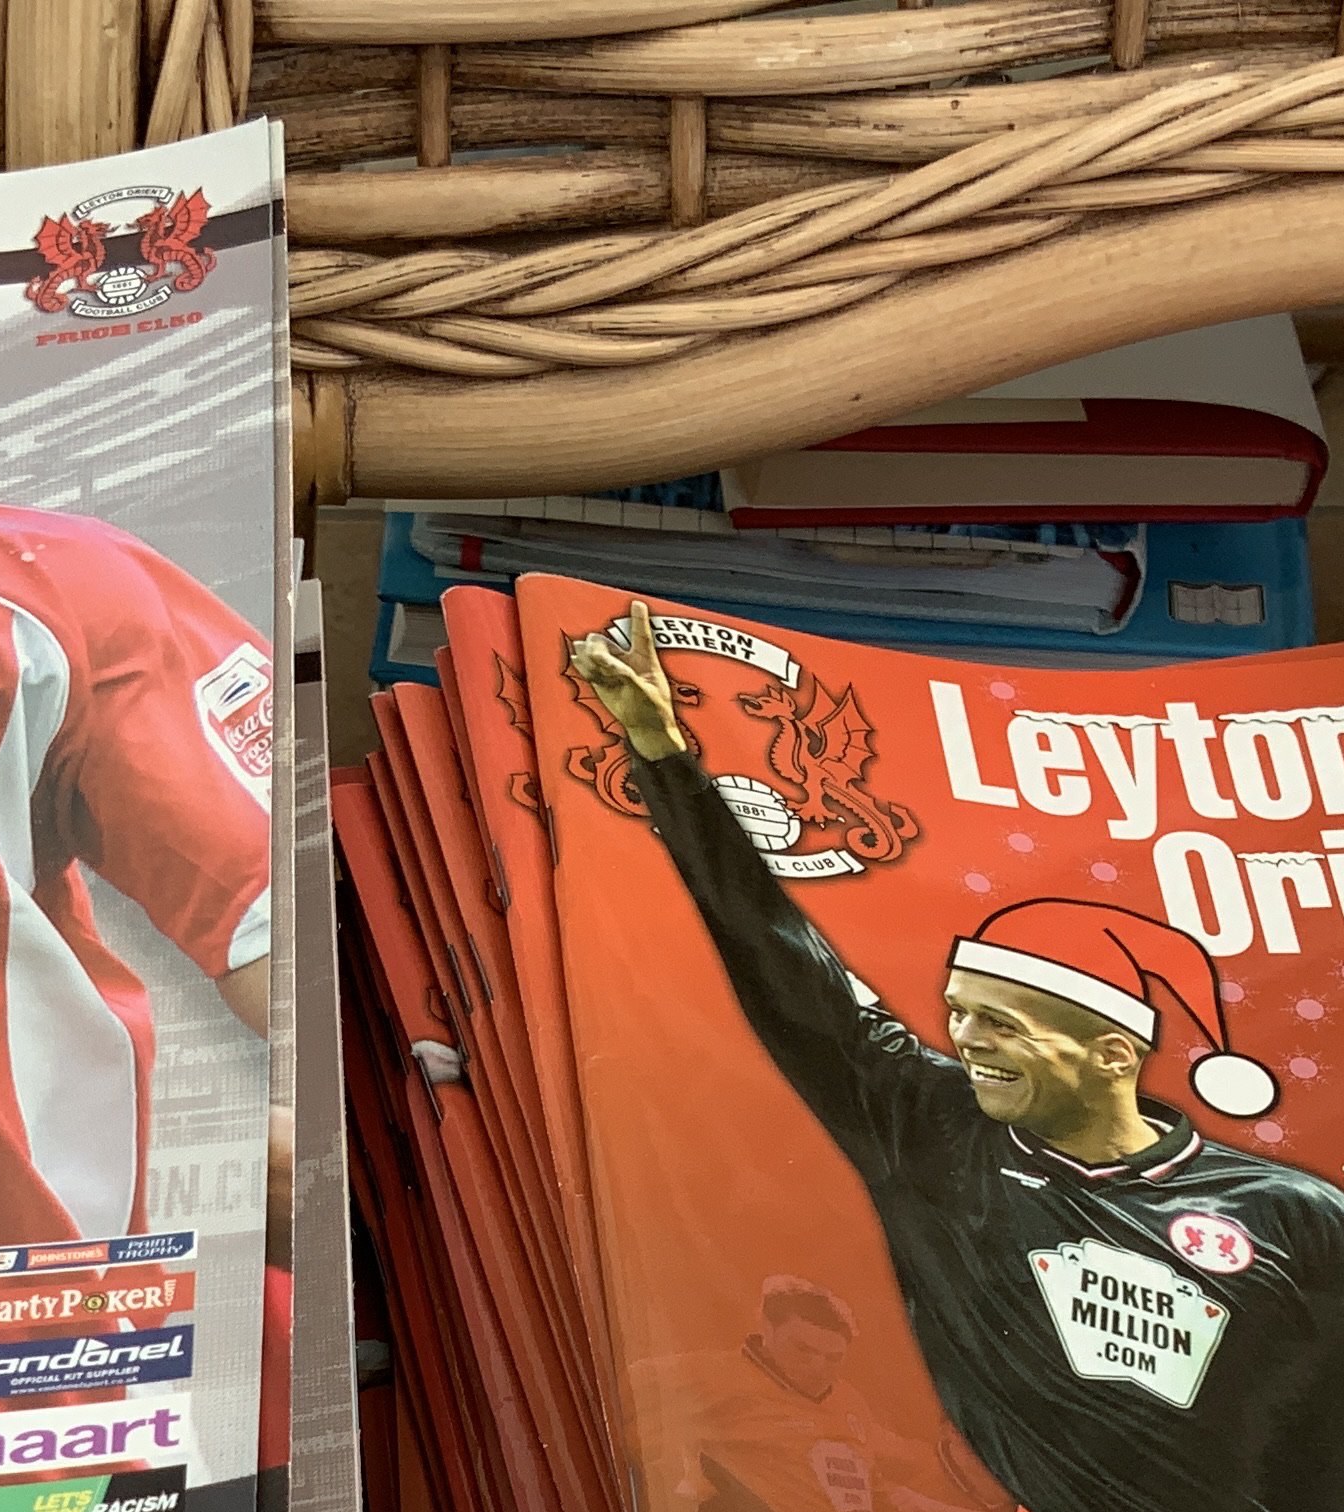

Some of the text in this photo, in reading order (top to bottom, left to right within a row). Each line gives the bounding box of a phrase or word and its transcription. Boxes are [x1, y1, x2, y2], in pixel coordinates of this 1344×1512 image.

[651, 617, 754, 650] LEYTON
[655, 631, 756, 661] ORIENT
[736, 803, 767, 817] 1881
[792, 857, 835, 873] CLUB
[116, 1243, 185, 1261] TROPHY
[127, 1235, 177, 1250] PAINT
[1080, 1268, 1177, 1320] POKER
[1070, 1297, 1193, 1357] MILLION
[1096, 1342, 1158, 1375] .COM
[32, 1489, 94, 1511] LET'S
